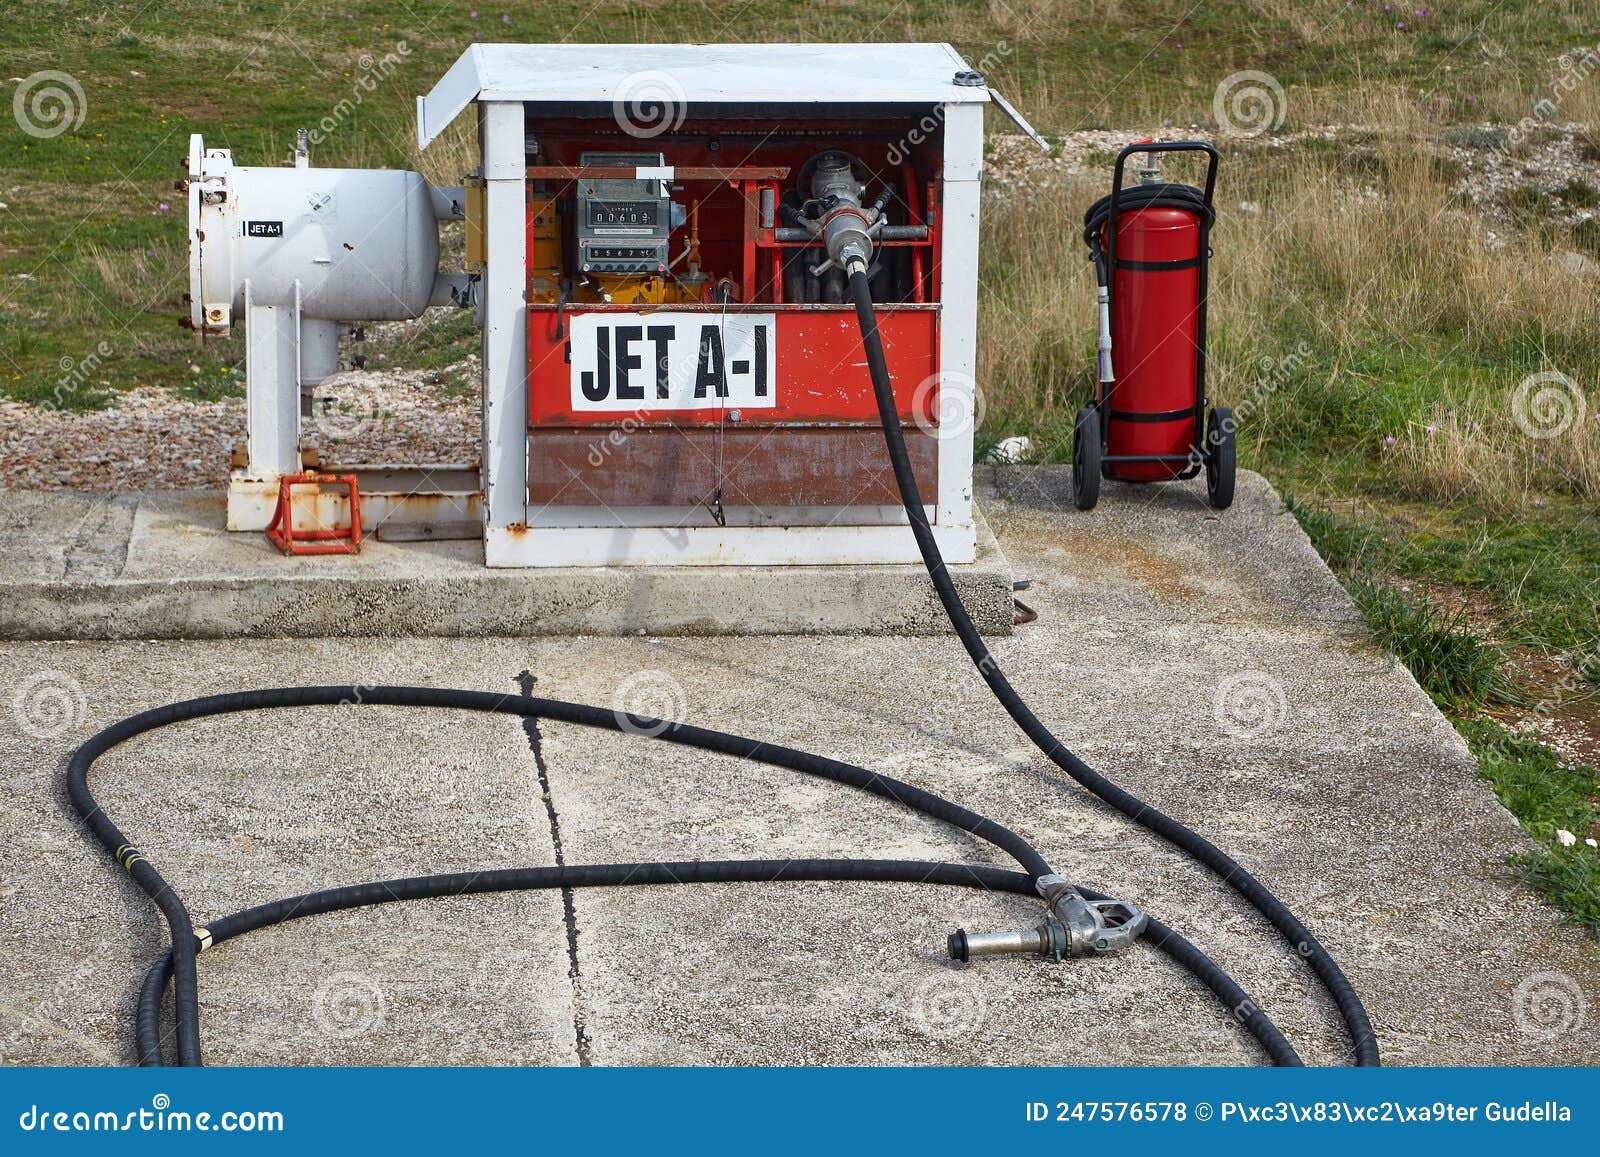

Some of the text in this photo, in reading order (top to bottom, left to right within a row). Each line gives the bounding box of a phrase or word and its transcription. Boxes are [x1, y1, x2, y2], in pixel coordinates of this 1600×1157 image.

[250, 224, 280, 233] JET A-1
[581, 325, 676, 402] JET
